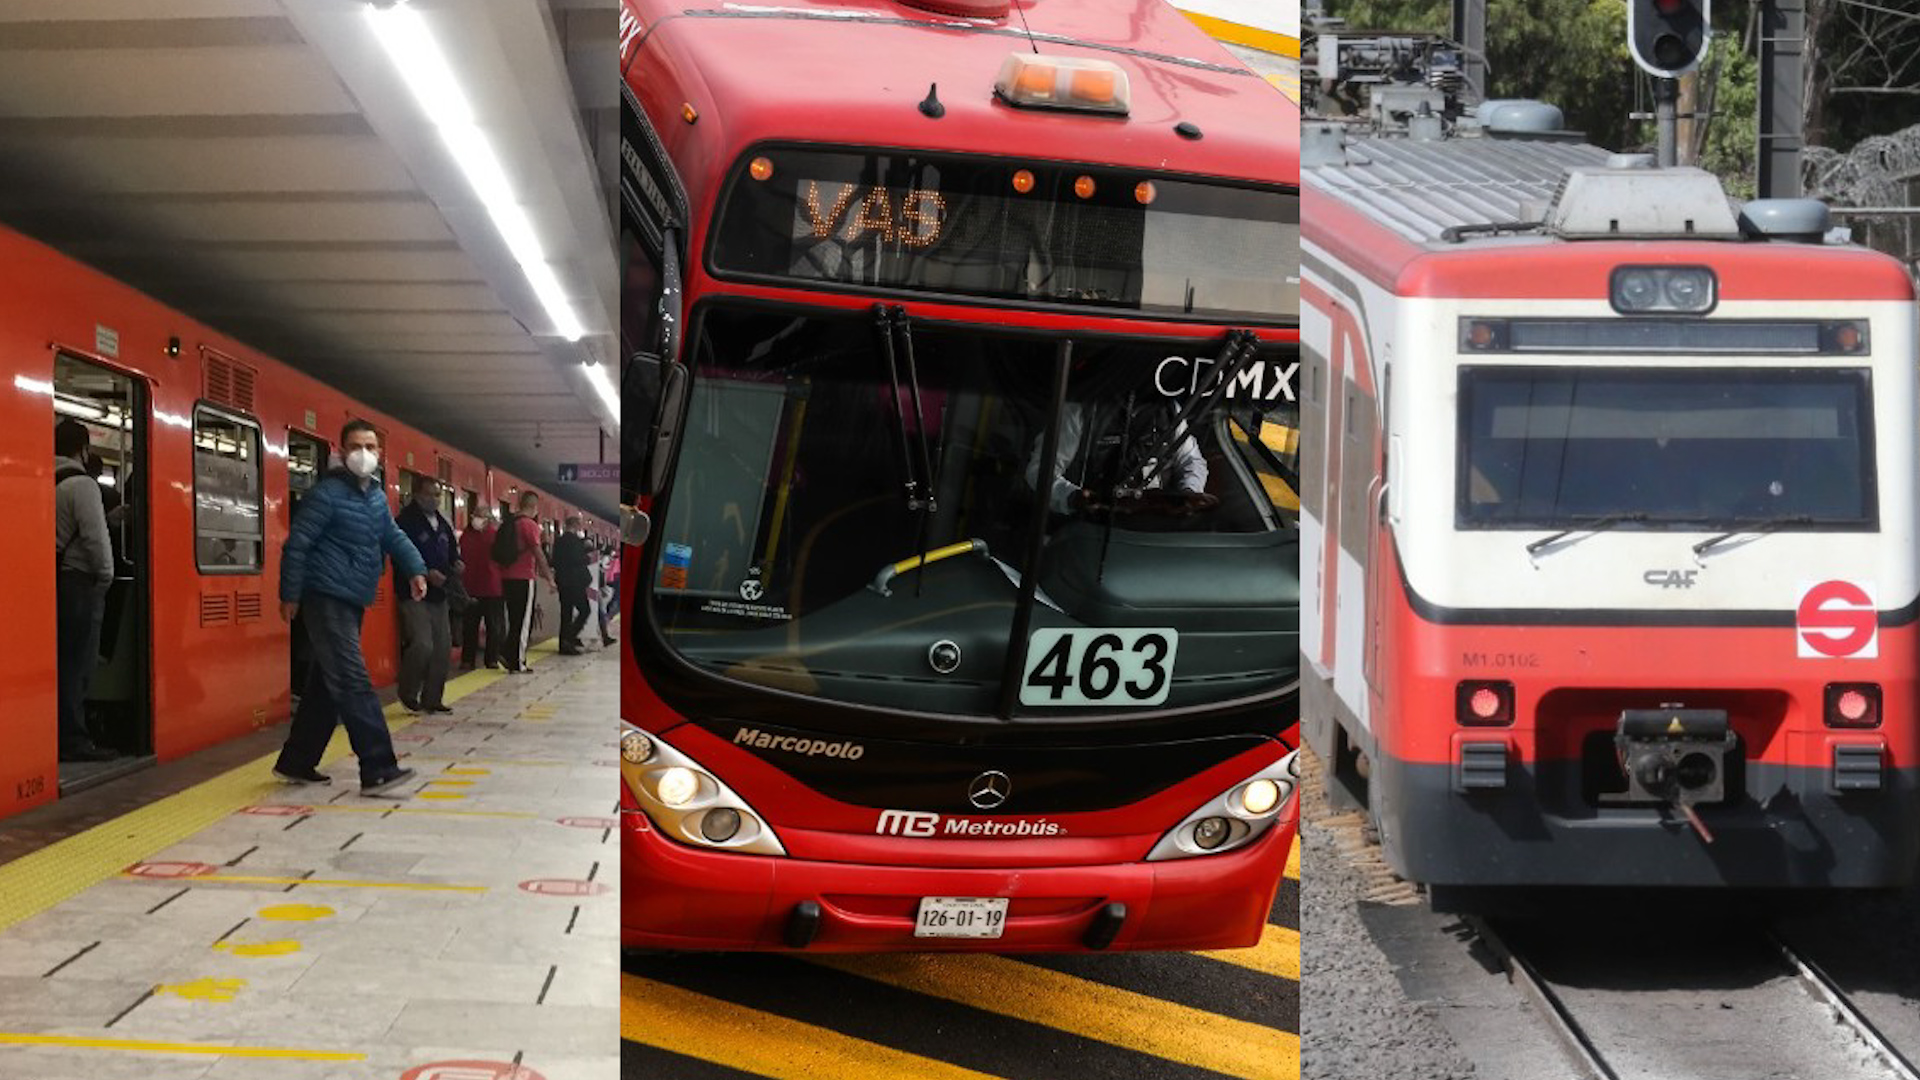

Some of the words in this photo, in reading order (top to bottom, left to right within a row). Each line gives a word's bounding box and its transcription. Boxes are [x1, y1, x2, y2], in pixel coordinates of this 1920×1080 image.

[1154, 356, 1300, 401] CDMX
[1643, 570, 1698, 588] CAF
[1027, 633, 1168, 700] 463
[1462, 653, 1540, 668] M1.0102
[733, 727, 864, 760] Marcopolo
[943, 818, 1060, 836] Metrobús
[922, 910, 1003, 927] 126-01-19
